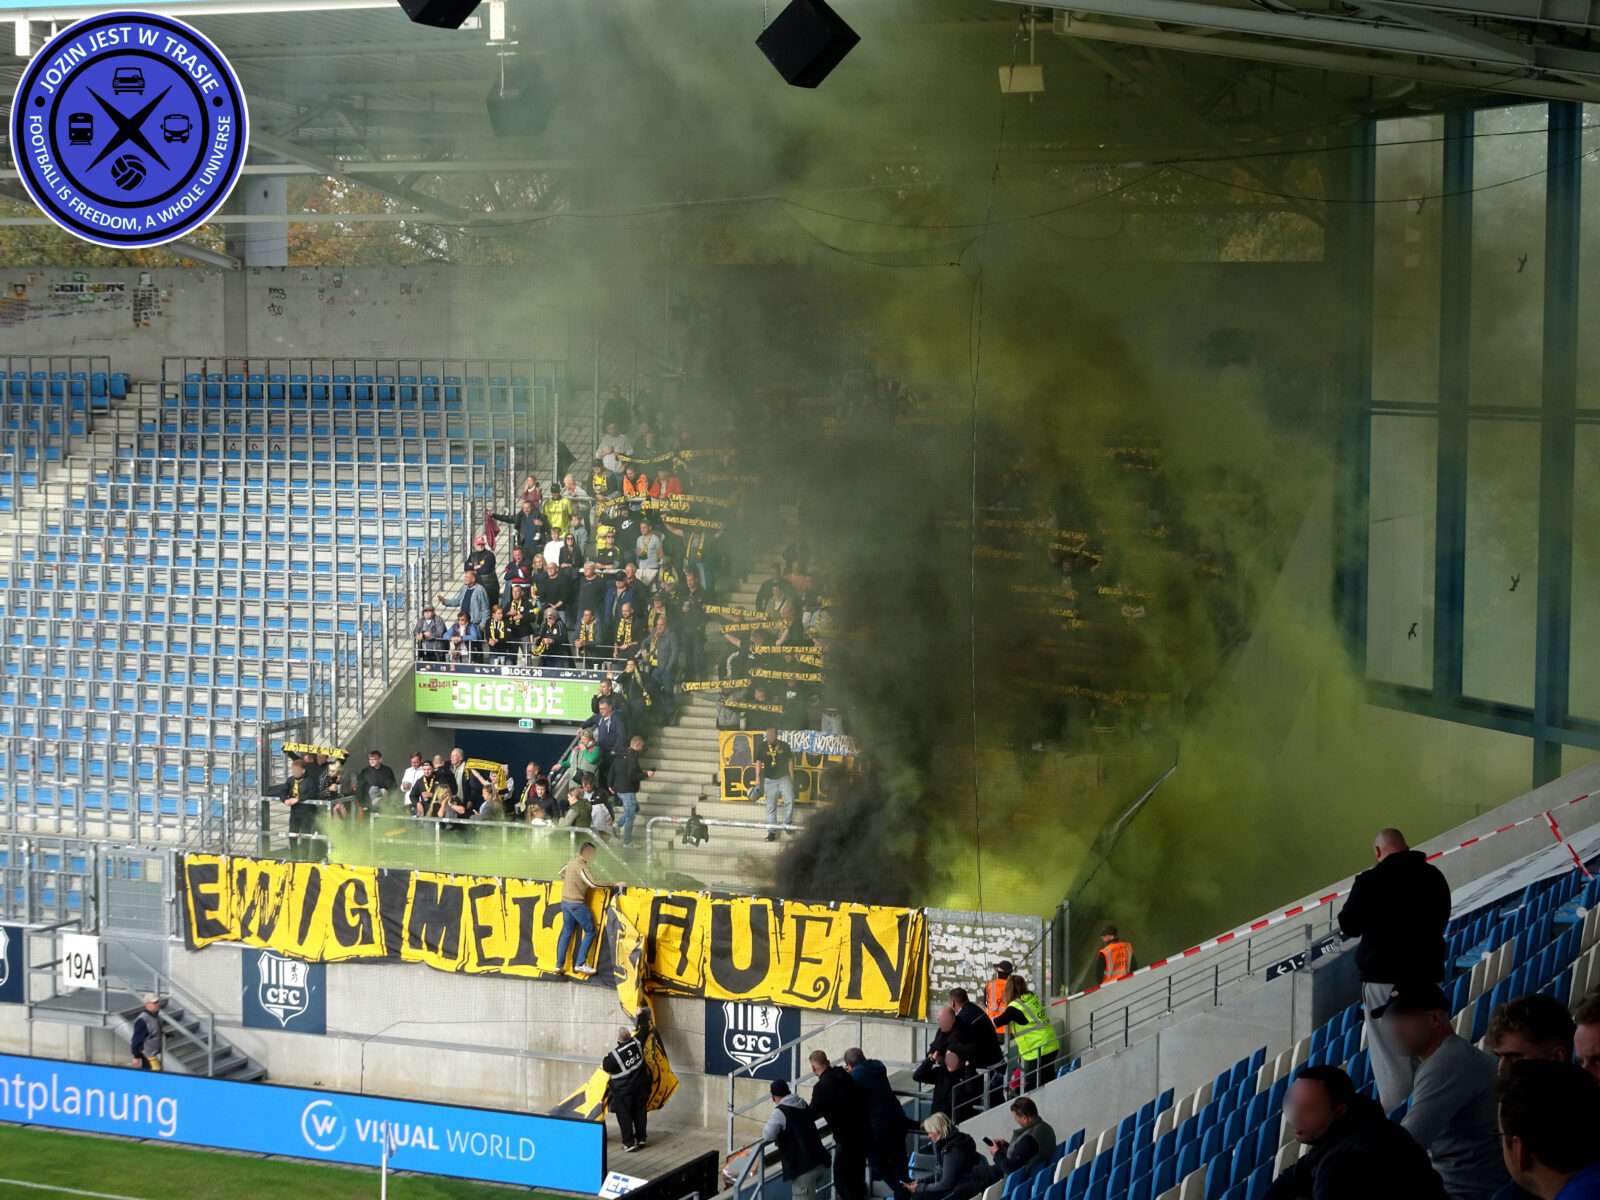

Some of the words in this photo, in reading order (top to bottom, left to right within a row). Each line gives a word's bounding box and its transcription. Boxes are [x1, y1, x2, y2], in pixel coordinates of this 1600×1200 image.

[504, 666, 531, 677] LOCK
[532, 668, 543, 677] 20
[452, 681, 564, 716] GGG.DE
[187, 863, 376, 947] EWIG
[65, 952, 96, 981] 19A
[266, 987, 300, 1005] CFC
[732, 1033, 771, 1053] CFC
[446, 1128, 536, 1162] WORLD
